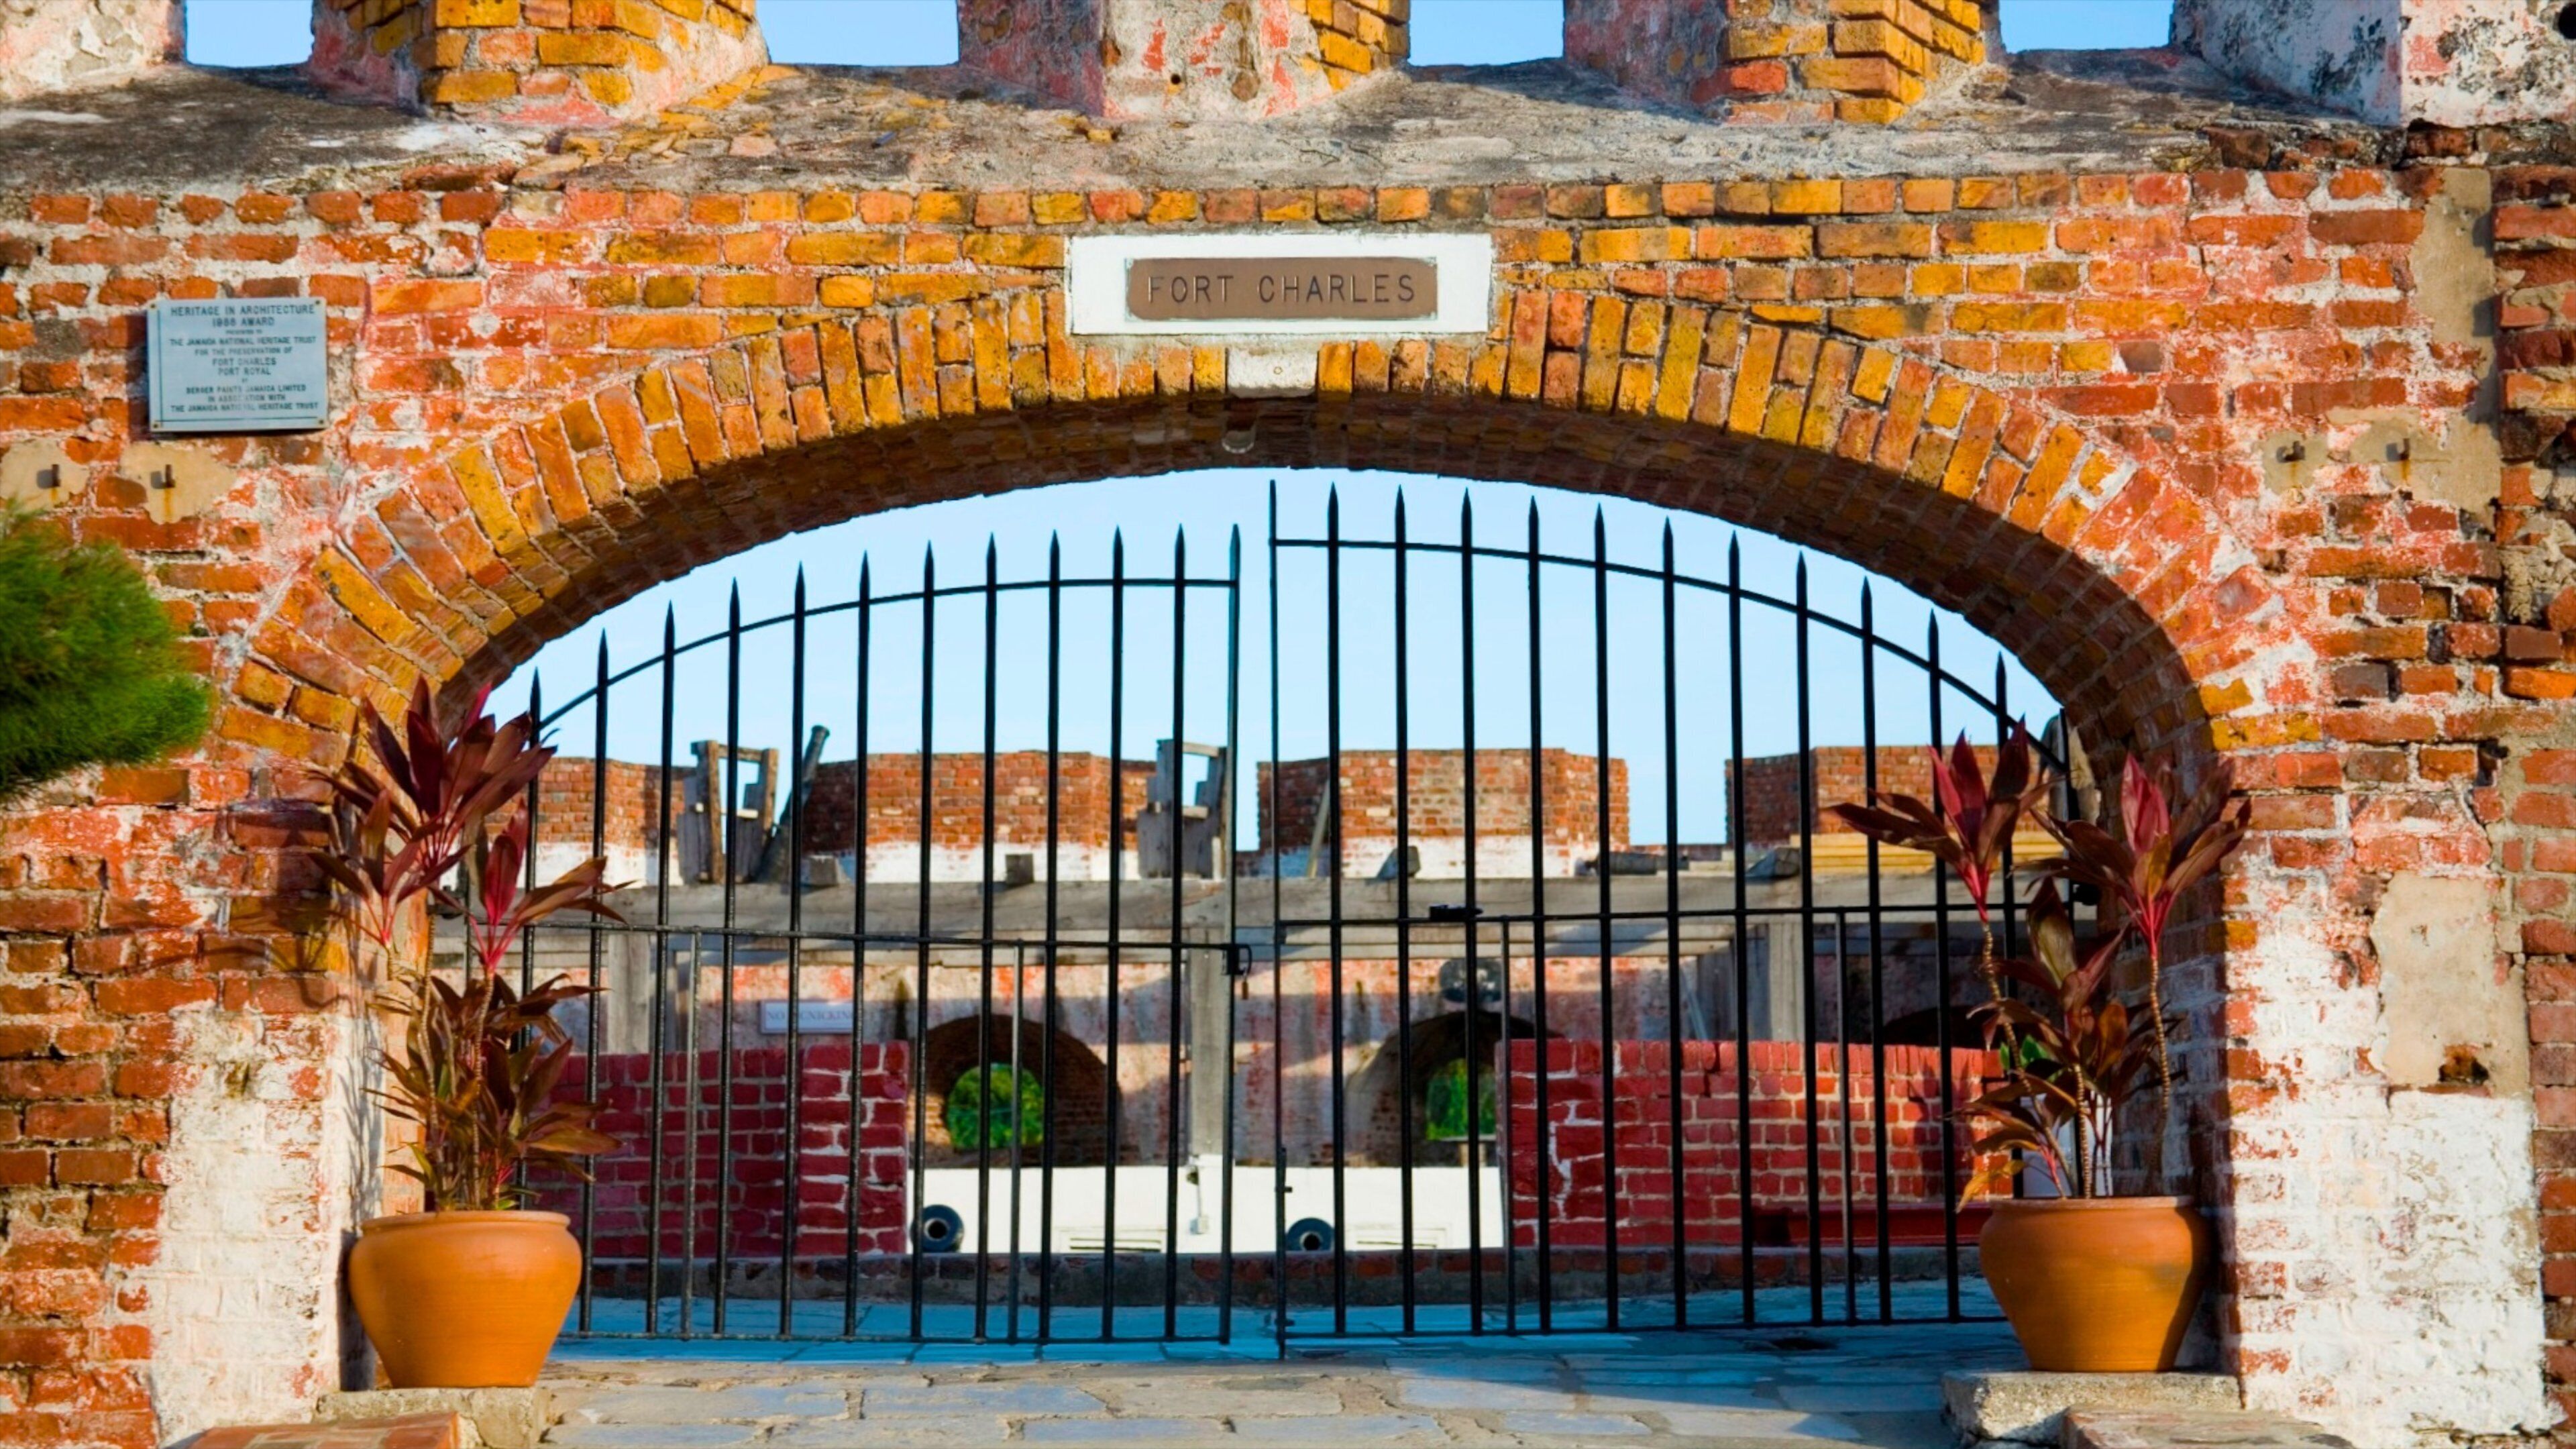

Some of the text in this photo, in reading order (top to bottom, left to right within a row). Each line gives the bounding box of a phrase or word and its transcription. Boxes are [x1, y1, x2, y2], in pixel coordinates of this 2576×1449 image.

[1147, 274, 1415, 304] FORT CHARLES
[170, 304, 315, 317] HERITAGE IN ARCHITECTURE
[240, 317, 275, 325] AWARD
[294, 335, 317, 343] TRUST
[212, 357, 277, 366] FORT CHARLES
[217, 367, 271, 376] PORT ROYAL
[278, 384, 307, 392] LIMITED
[767, 1010, 786, 1020] NO
